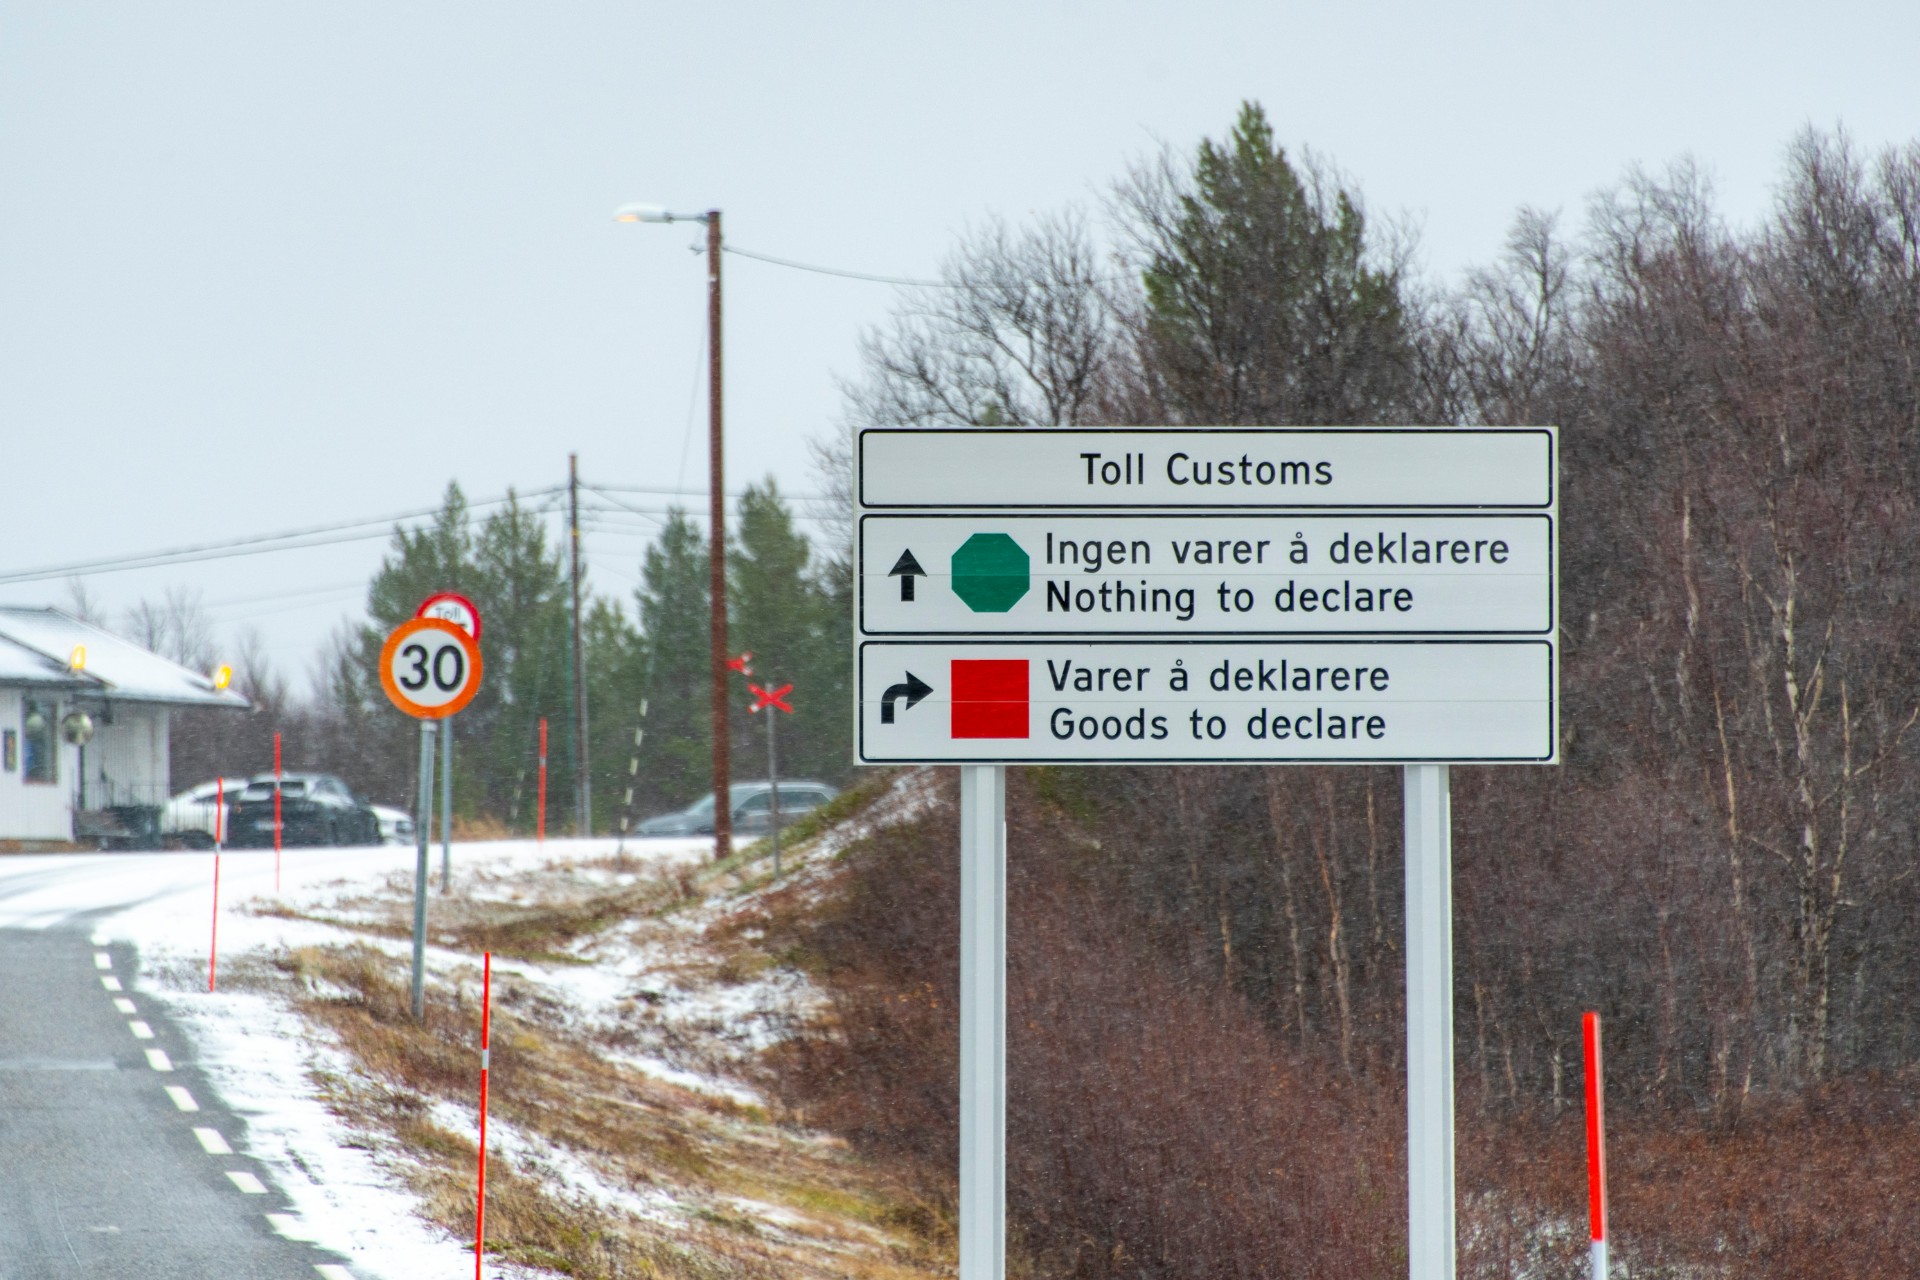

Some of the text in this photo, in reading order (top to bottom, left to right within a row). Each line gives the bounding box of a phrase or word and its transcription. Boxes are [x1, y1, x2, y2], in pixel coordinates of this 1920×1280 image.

[1080, 452, 1333, 486] Toll Customs
[1047, 531, 1509, 571] Ingen varer å deklarere
[434, 606, 461, 620] Toll
[1047, 580, 1414, 620] Nothing to declare
[400, 644, 464, 691] 30
[1047, 658, 1390, 692] Varer å deklarere
[1050, 707, 1386, 741] Goods to declare
